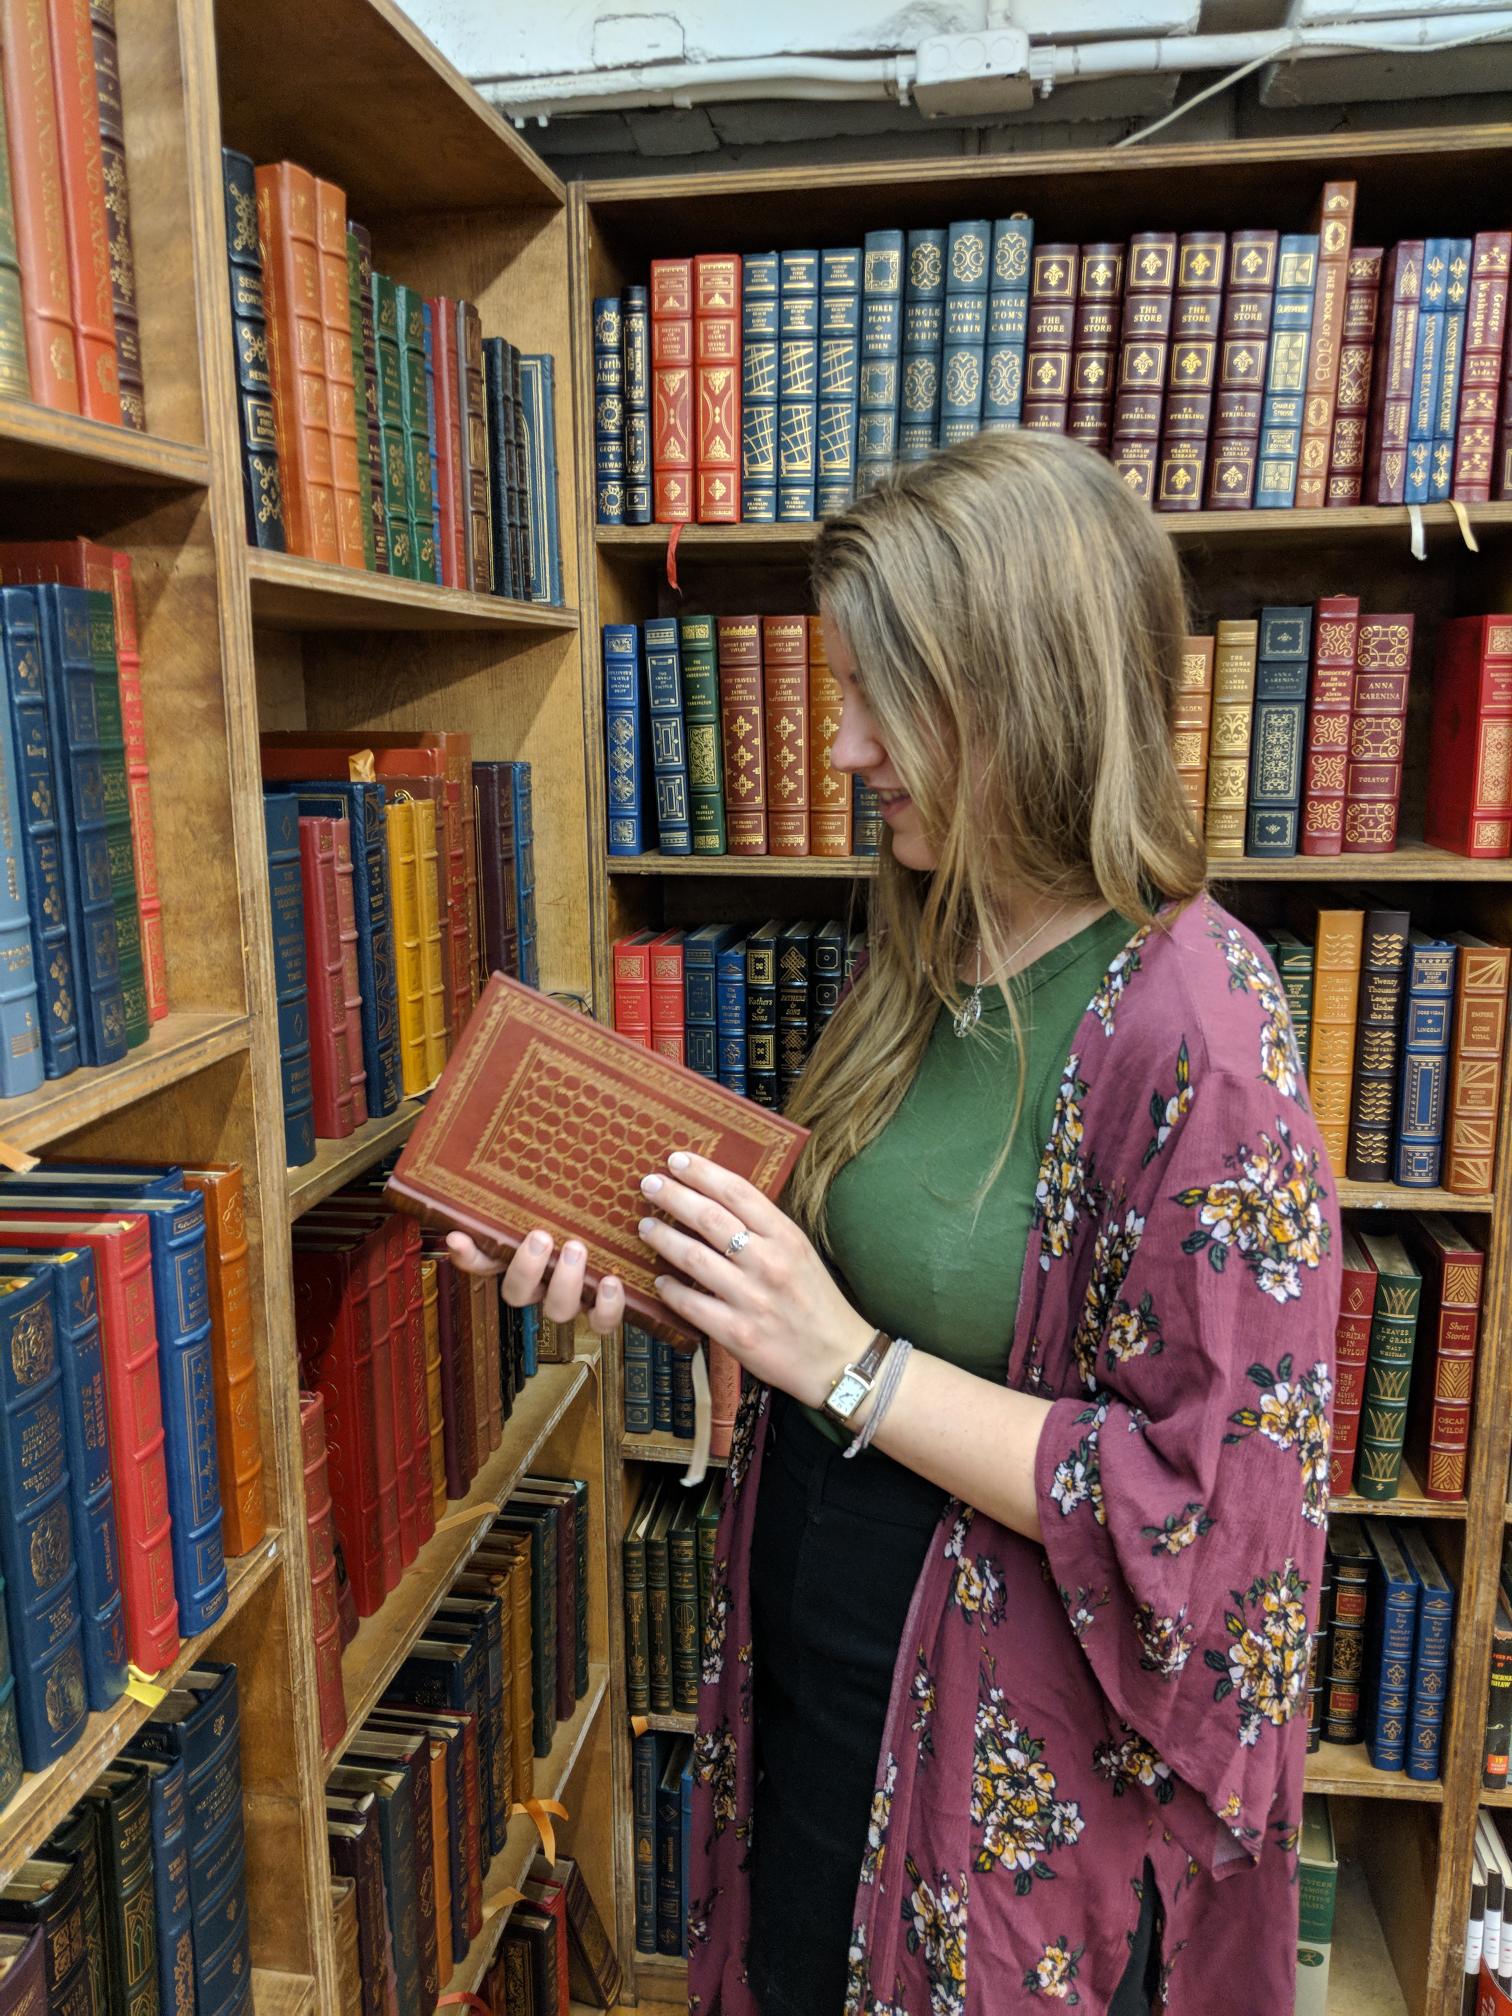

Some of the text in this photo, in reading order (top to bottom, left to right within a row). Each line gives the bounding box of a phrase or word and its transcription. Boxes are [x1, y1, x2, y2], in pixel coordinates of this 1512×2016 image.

[82, 130, 101, 197] AND
[949, 301, 983, 309] UNCLE
[992, 299, 1025, 308] UNCLE
[1239, 304, 1258, 312] THE
[908, 308, 940, 317] UNCLE
[1139, 305, 1158, 314] THE
[1187, 306, 1206, 314] THE
[1472, 282, 1490, 345] Washington
[1488, 293, 1503, 332] George
[951, 313, 980, 321] TOM'S
[993, 311, 1023, 320] TOM'S
[1089, 316, 1107, 324] THE
[1133, 313, 1162, 322] STORE
[1182, 314, 1211, 323] STORE
[1233, 312, 1262, 321] STORE
[910, 319, 938, 328] TOM'S
[1042, 316, 1060, 325] THE
[1315, 269, 1336, 380] THE BOOK OF JOB
[949, 325, 981, 333] CABIN
[991, 323, 1024, 332] CABIN
[1036, 324, 1065, 333] STORE
[1083, 324, 1112, 332] STORE
[907, 331, 938, 340] CABIN
[1404, 322, 1413, 360] PRINCIPLES
[1391, 344, 1402, 390] MANAGEMENT
[1417, 316, 1436, 431] MONSIEUR BEAUCAIRE
[1440, 316, 1458, 432] MONSIEUR BEAUCAIRE
[1121, 413, 1156, 421] STRIBLING
[1317, 669, 1351, 677] Democracy
[1360, 692, 1400, 700] KARENINA
[27, 744, 47, 758] Liberty
[41, 846, 54, 857] John
[40, 859, 57, 871] Stuart
[1373, 977, 1398, 987] Twenty
[1368, 985, 1399, 994] Thousand
[748, 997, 773, 1006] Fathers
[780, 994, 807, 1002] FATHERS
[1370, 995, 1397, 1005] Leagues
[756, 1006, 765, 1014] &
[1372, 1003, 1394, 1011] Under
[751, 1012, 768, 1021] Sons
[1349, 1324, 1355, 1332] A
[1448, 1321, 1469, 1331] Short
[1381, 1327, 1409, 1336] LEAVES
[1445, 1331, 1471, 1341] Stories
[1376, 1334, 1412, 1344] OF GRASS
[1379, 1350, 1406, 1358] WHITMAN
[92, 1370, 106, 1448] BEHIND
[1438, 1416, 1465, 1425] OSCAR
[1437, 1425, 1464, 1434] WILDE
[21, 1452, 33, 1468] OF
[1491, 1680, 1511, 1688] SHAW
